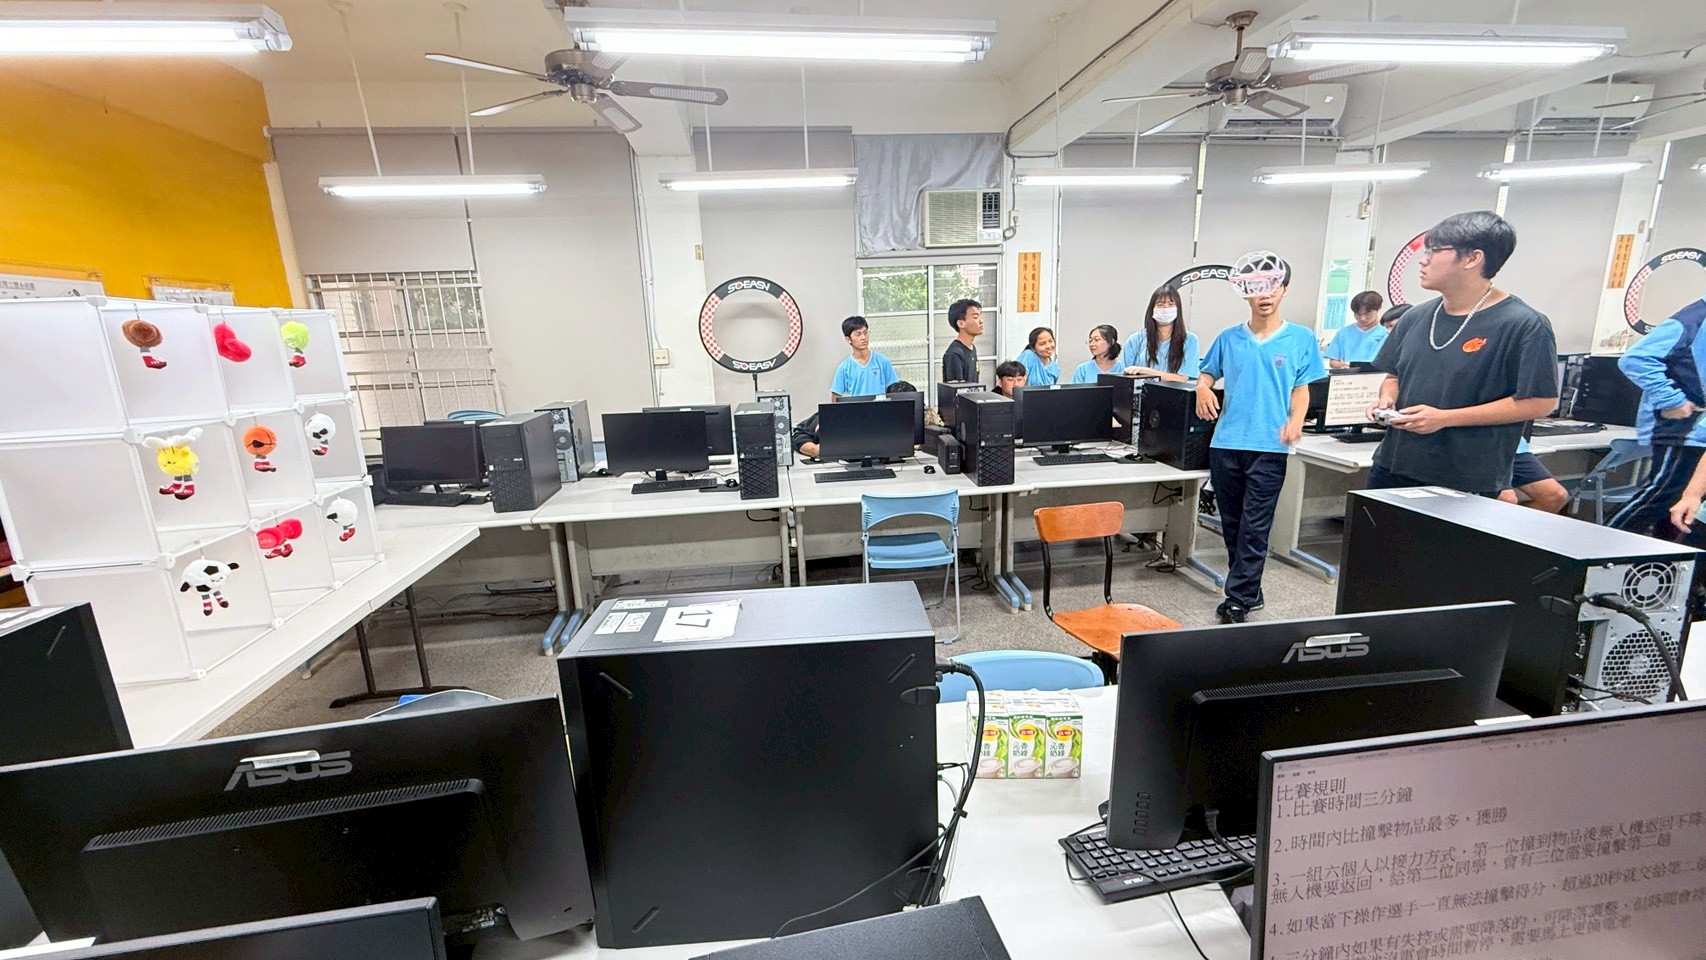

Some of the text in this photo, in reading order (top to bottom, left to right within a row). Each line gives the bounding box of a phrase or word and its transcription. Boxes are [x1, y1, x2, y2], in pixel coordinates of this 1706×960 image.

[675, 609, 713, 628] 17
[1282, 636, 1370, 663] ASUS
[224, 750, 352, 791] ASUS
[1276, 777, 1347, 802] 比賽規則
[1276, 786, 1414, 819] 1.比賽時間三分鐘
